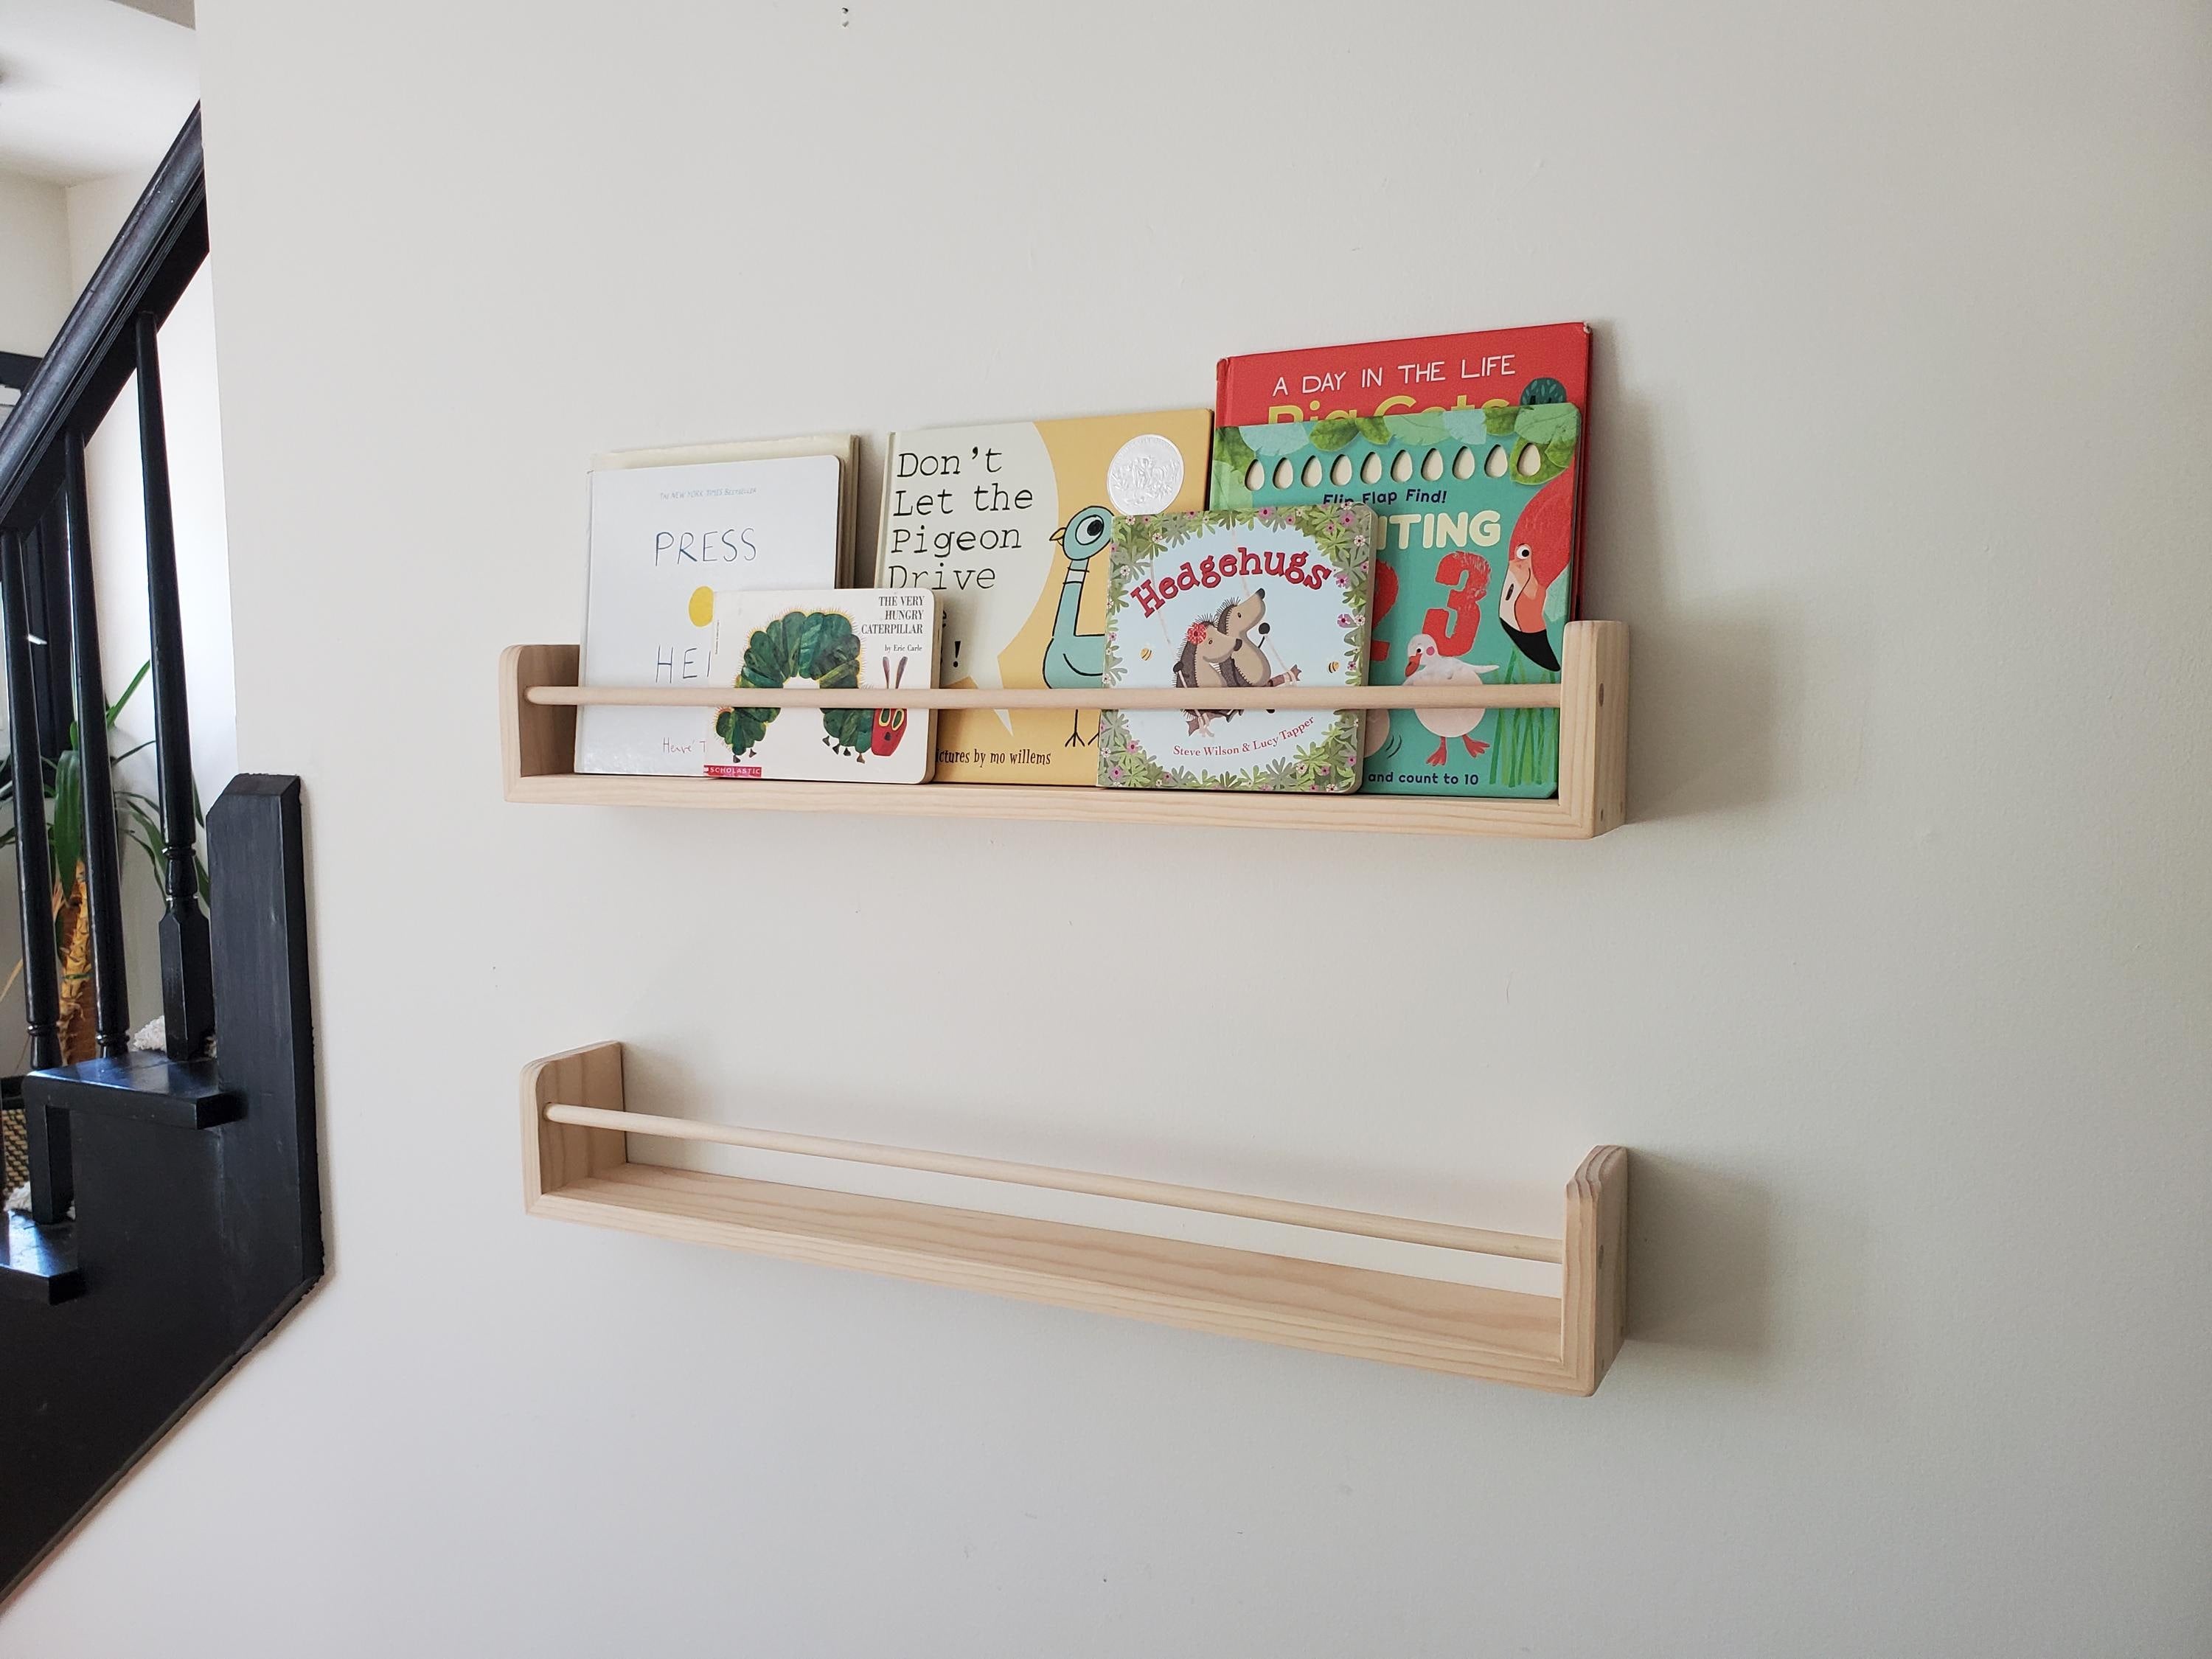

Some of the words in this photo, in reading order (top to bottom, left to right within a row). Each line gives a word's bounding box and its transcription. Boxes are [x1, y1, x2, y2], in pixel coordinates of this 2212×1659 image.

[1272, 377, 1289, 397] A
[1301, 371, 1347, 394] DAY
[1361, 367, 1382, 389] IN
[1397, 361, 1446, 383] THE
[1461, 355, 1516, 380] LIFE
[897, 446, 1003, 478] Don't
[893, 489, 953, 516] Let
[974, 483, 1033, 511] the
[1363, 491, 1397, 505] Flap
[1405, 489, 1447, 504] Find!
[891, 525, 1022, 557] Pigeon
[1377, 509, 1501, 551] TING
[655, 528, 756, 566] PRESS
[888, 563, 995, 590] Drive
[1130, 547, 1332, 618] Hedgehugs
[878, 596, 897, 606] THE
[900, 595, 925, 606] VERY
[885, 609, 924, 620] HUNGRY
[1422, 550, 1492, 657] 3
[861, 624, 923, 634] CATERPILLAR
[885, 644, 891, 653] by
[894, 644, 905, 652] Eric
[907, 644, 922, 652] Carle
[1173, 745, 1201, 757] Steve
[1203, 745, 1239, 757] Wilson
[1242, 743, 1251, 752] &
[1253, 737, 1279, 750] Lucy
[1279, 716, 1315, 740] Tapper
[709, 767, 761, 775] SCHOLASTIC
[936, 748, 970, 763] ictures
[973, 748, 986, 768] by
[990, 752, 1005, 765] mo
[1010, 748, 1051, 765] willems
[1368, 771, 1394, 782] and
[1399, 773, 1439, 784] count
[1444, 773, 1458, 785] to
[1464, 774, 1478, 785] 10
